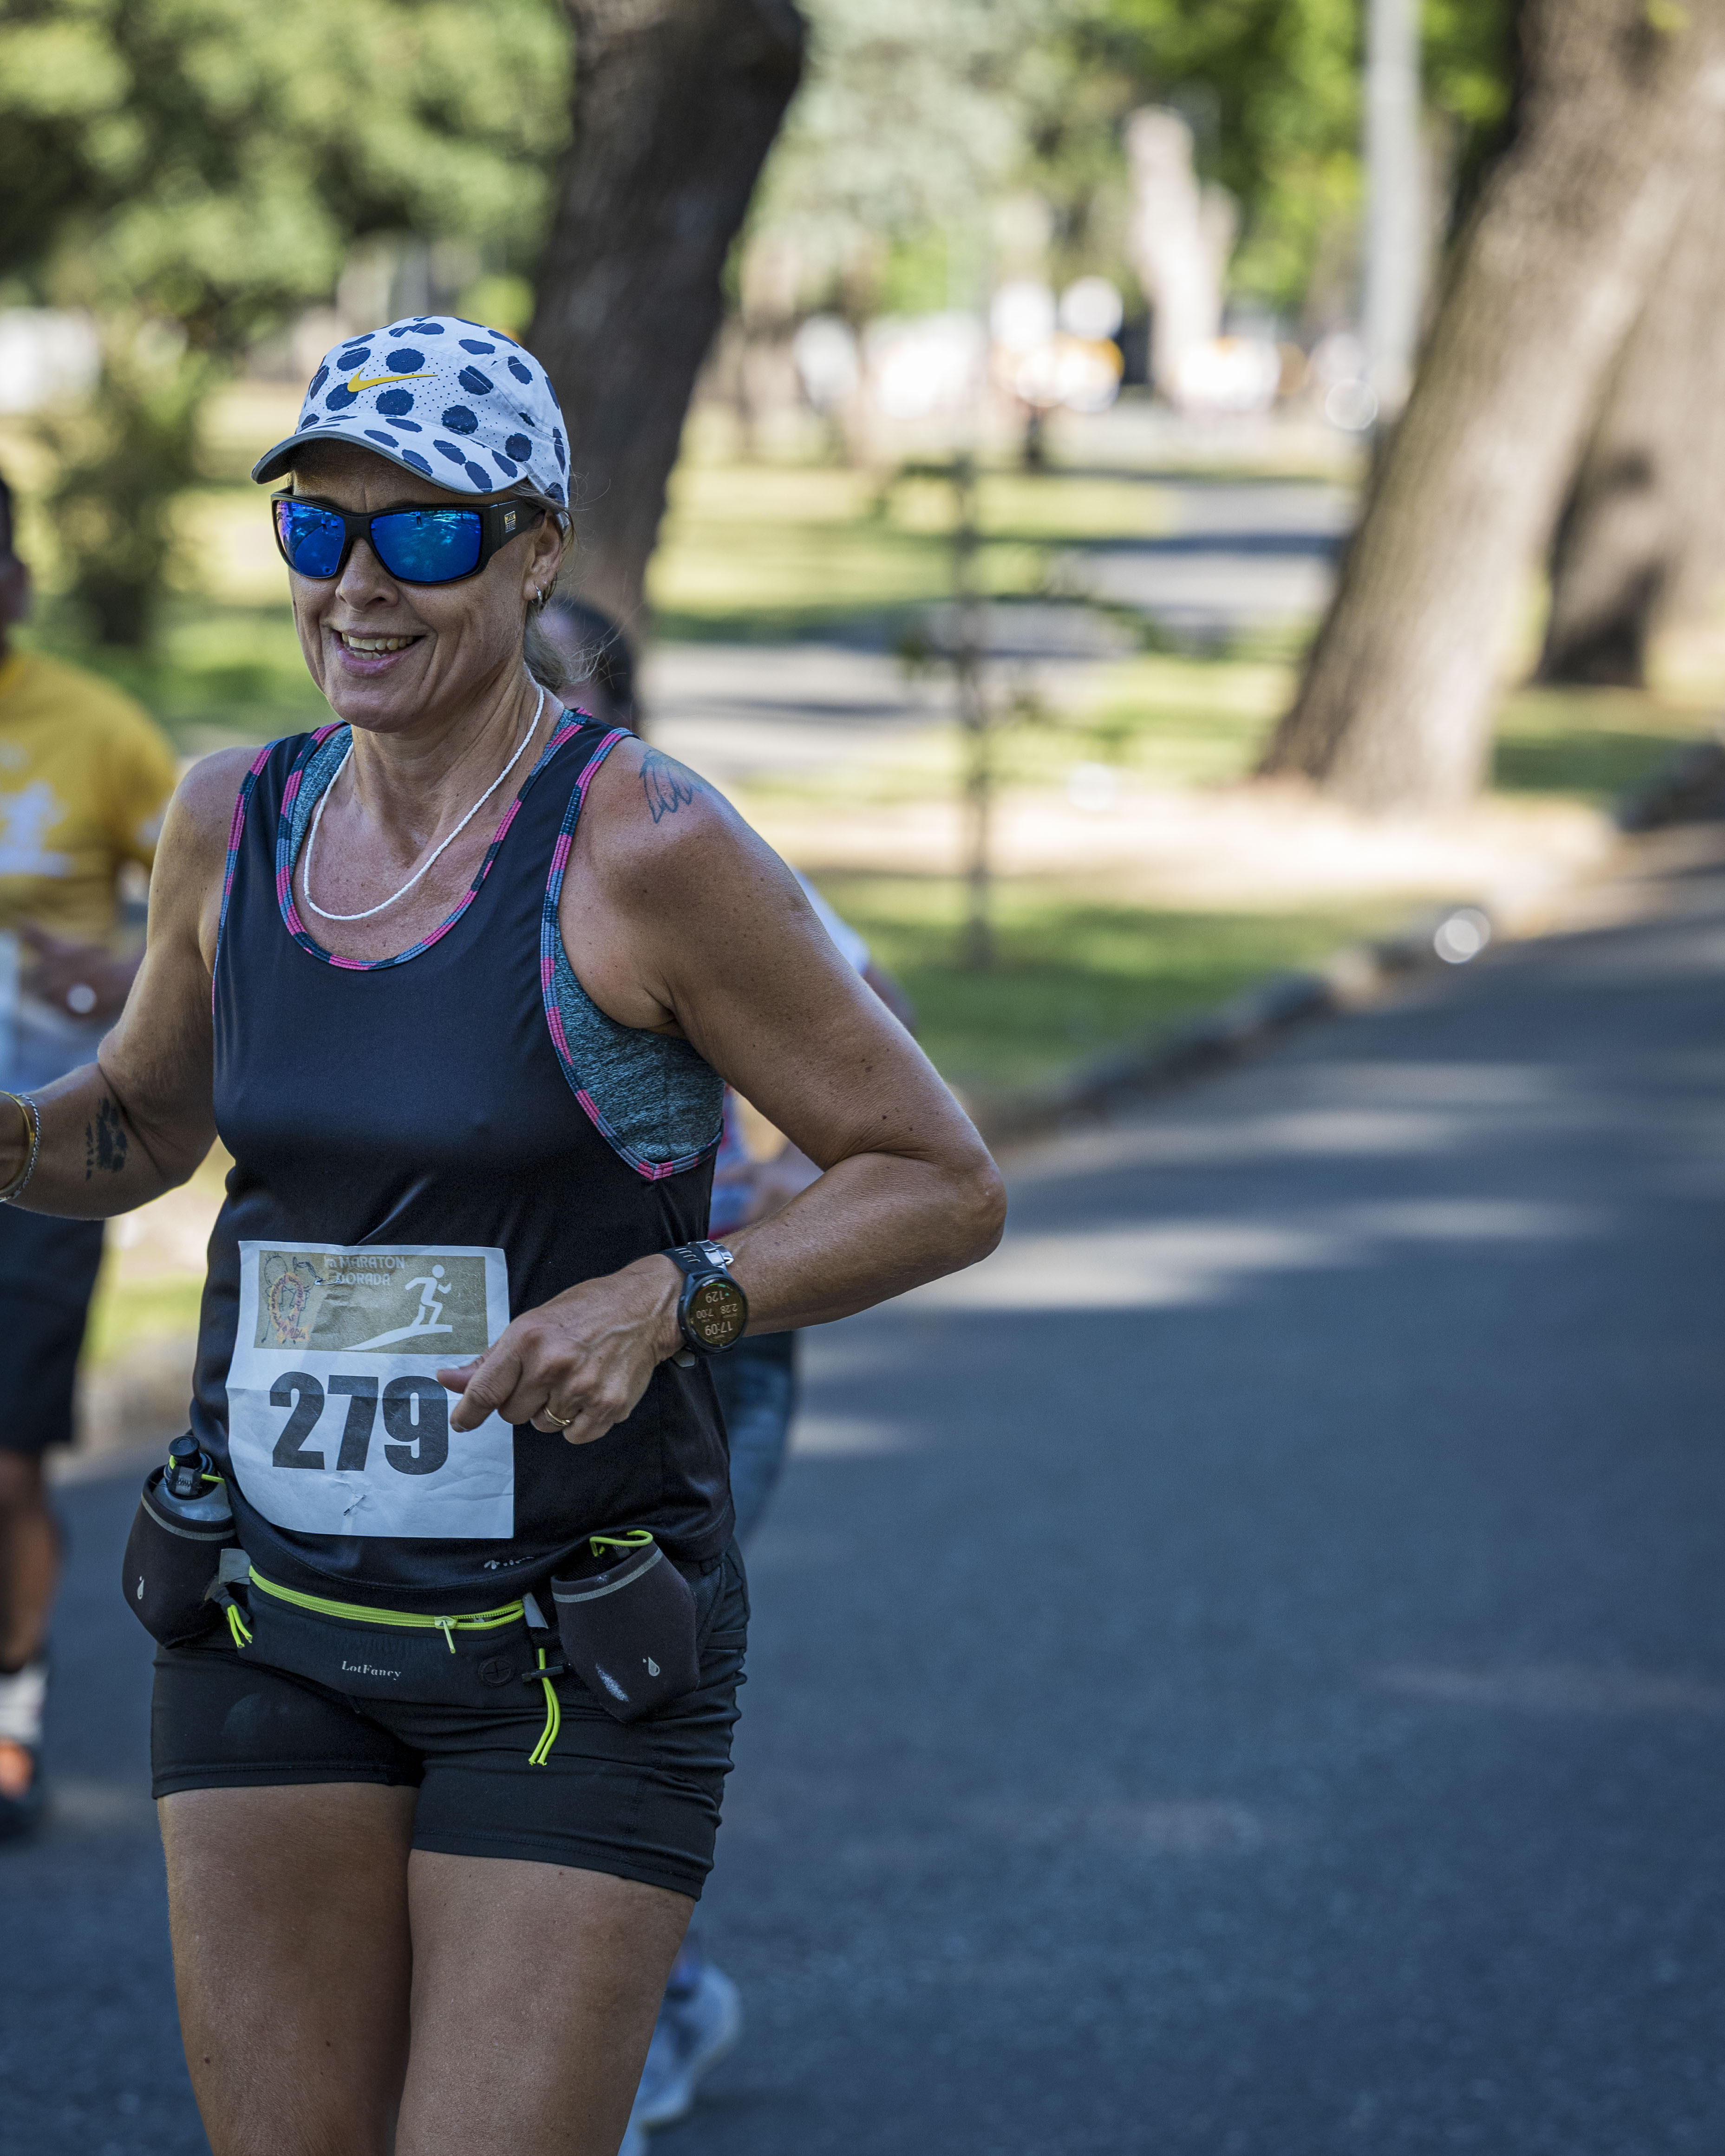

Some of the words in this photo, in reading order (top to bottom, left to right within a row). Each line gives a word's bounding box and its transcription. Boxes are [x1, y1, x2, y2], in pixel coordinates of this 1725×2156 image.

[706, 1291, 725, 1303] 129
[269, 1371, 449, 1475] 279
[342, 1661, 401, 1681] LotFancy
